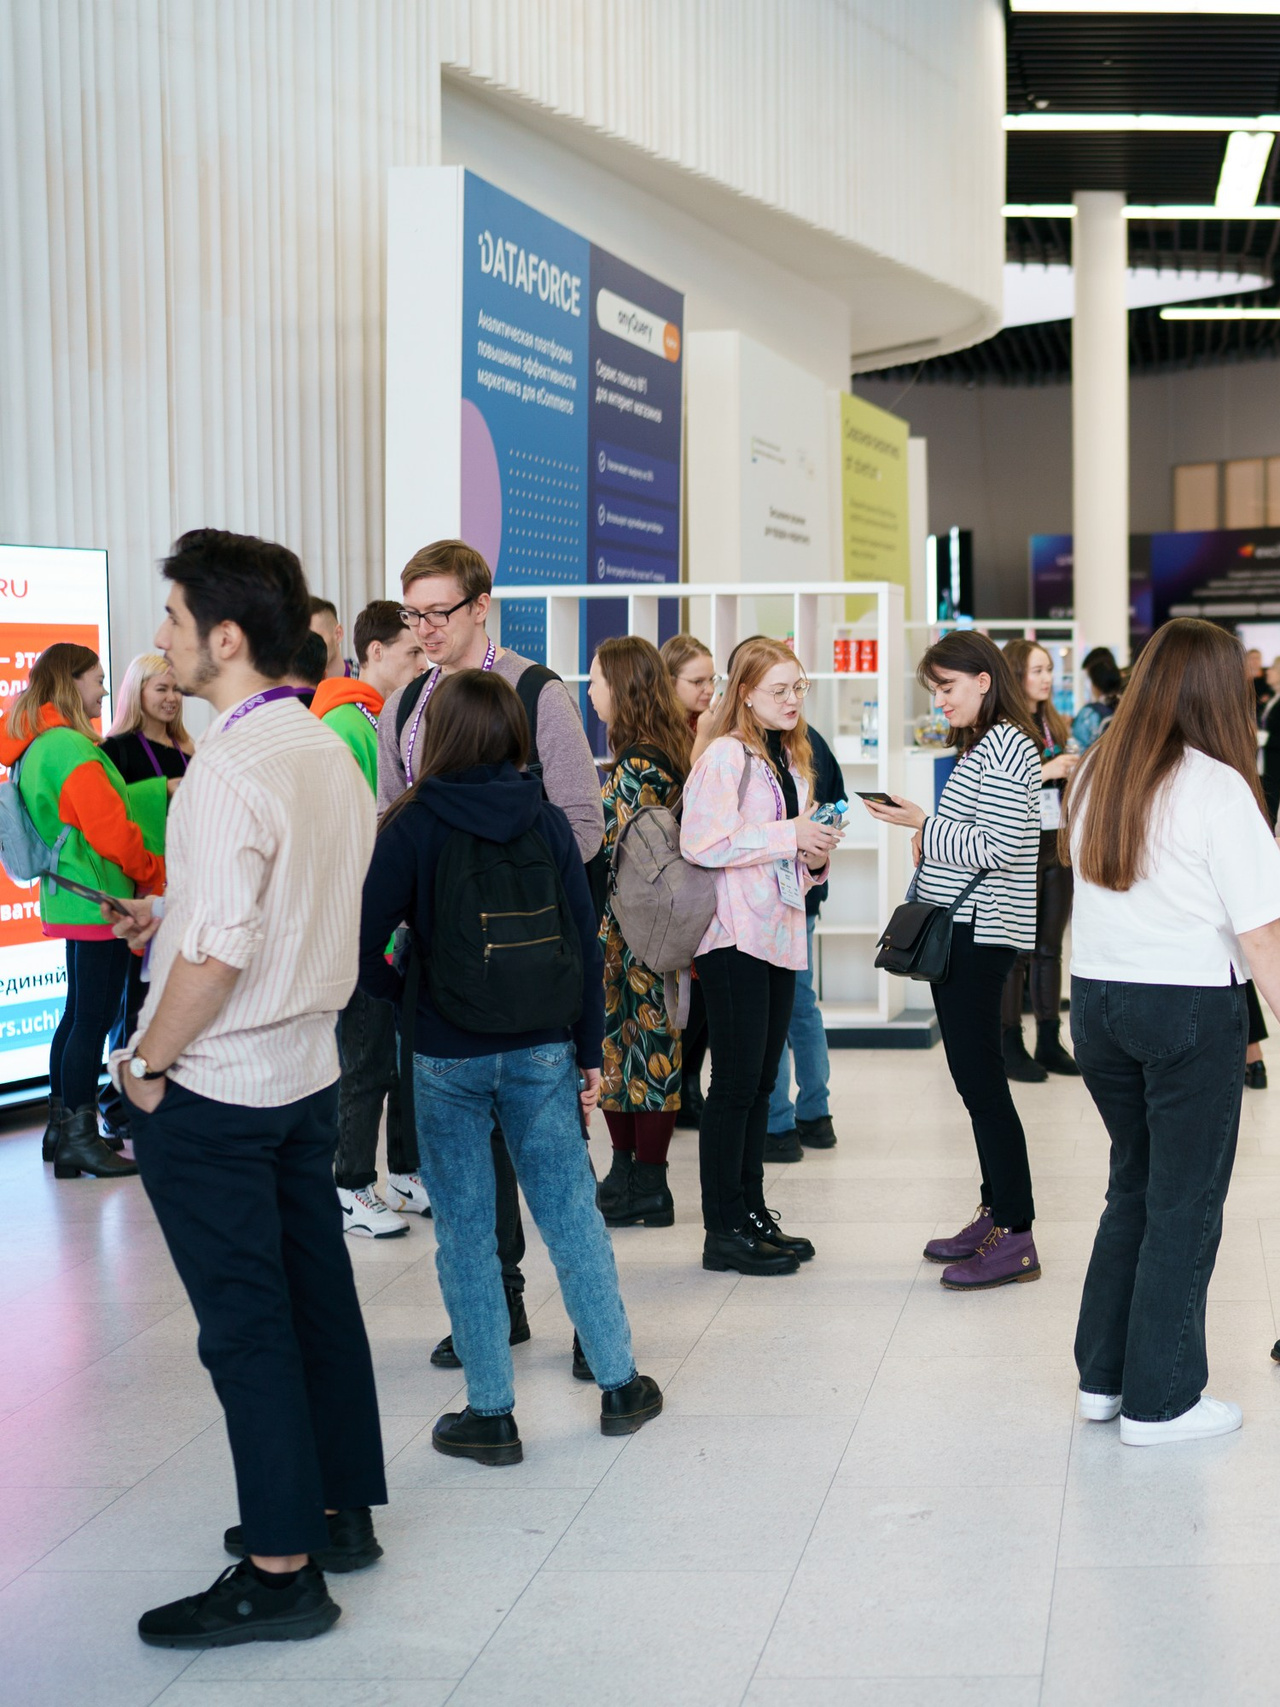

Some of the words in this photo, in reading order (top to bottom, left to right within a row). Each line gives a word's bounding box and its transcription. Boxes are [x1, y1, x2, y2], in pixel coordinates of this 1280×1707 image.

[478, 229, 581, 317] DATAFORCE
[477, 308, 534, 348] Аналитическая
[534, 336, 573, 365] платформа
[477, 339, 522, 370] повышения
[522, 354, 577, 391] эффективности
[477, 368, 521, 397] маркетинга
[522, 384, 536, 404] для
